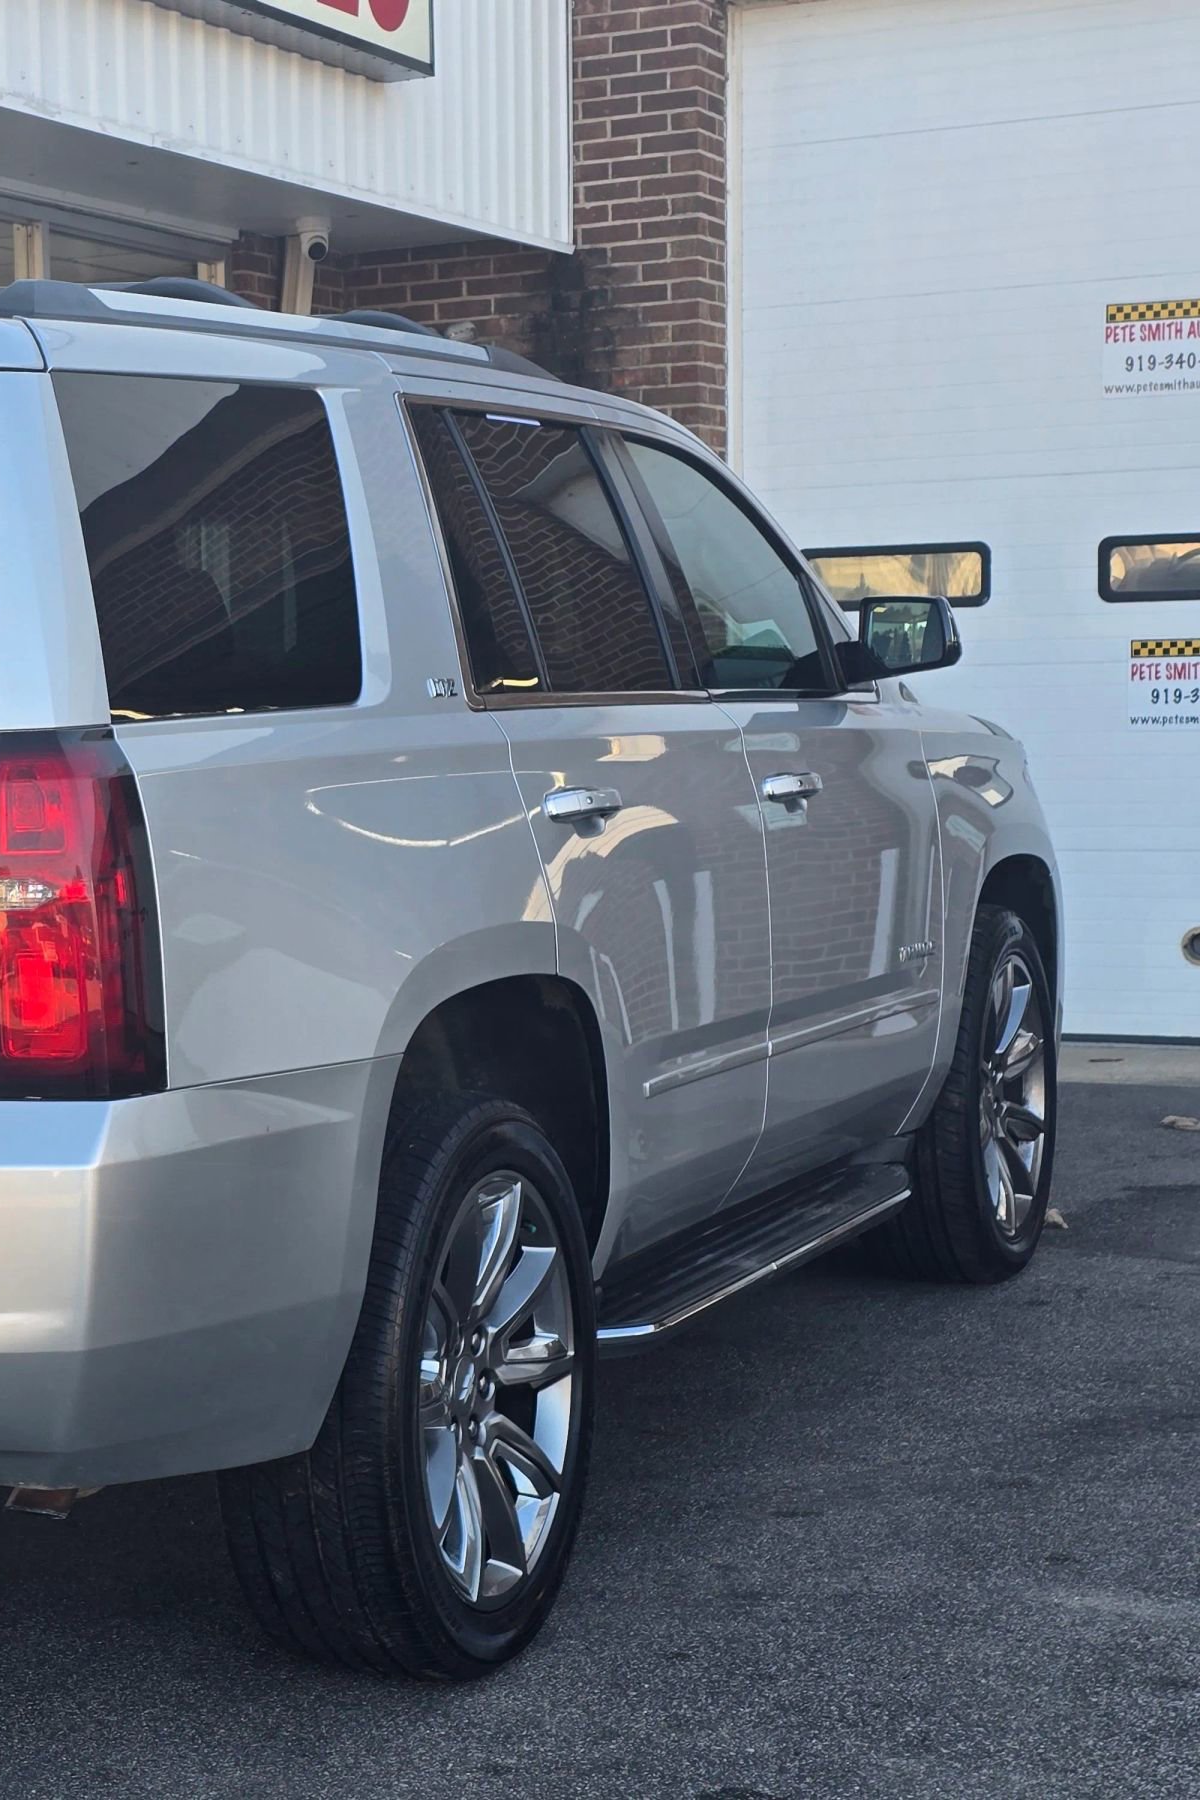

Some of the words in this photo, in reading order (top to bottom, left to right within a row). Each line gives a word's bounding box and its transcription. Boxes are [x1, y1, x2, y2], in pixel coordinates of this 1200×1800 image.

[1105, 325, 1136, 344] PETE
[1140, 321, 1183, 342] SMITH
[1125, 352, 1200, 372] 919-340
[1131, 662, 1161, 681] PETE
